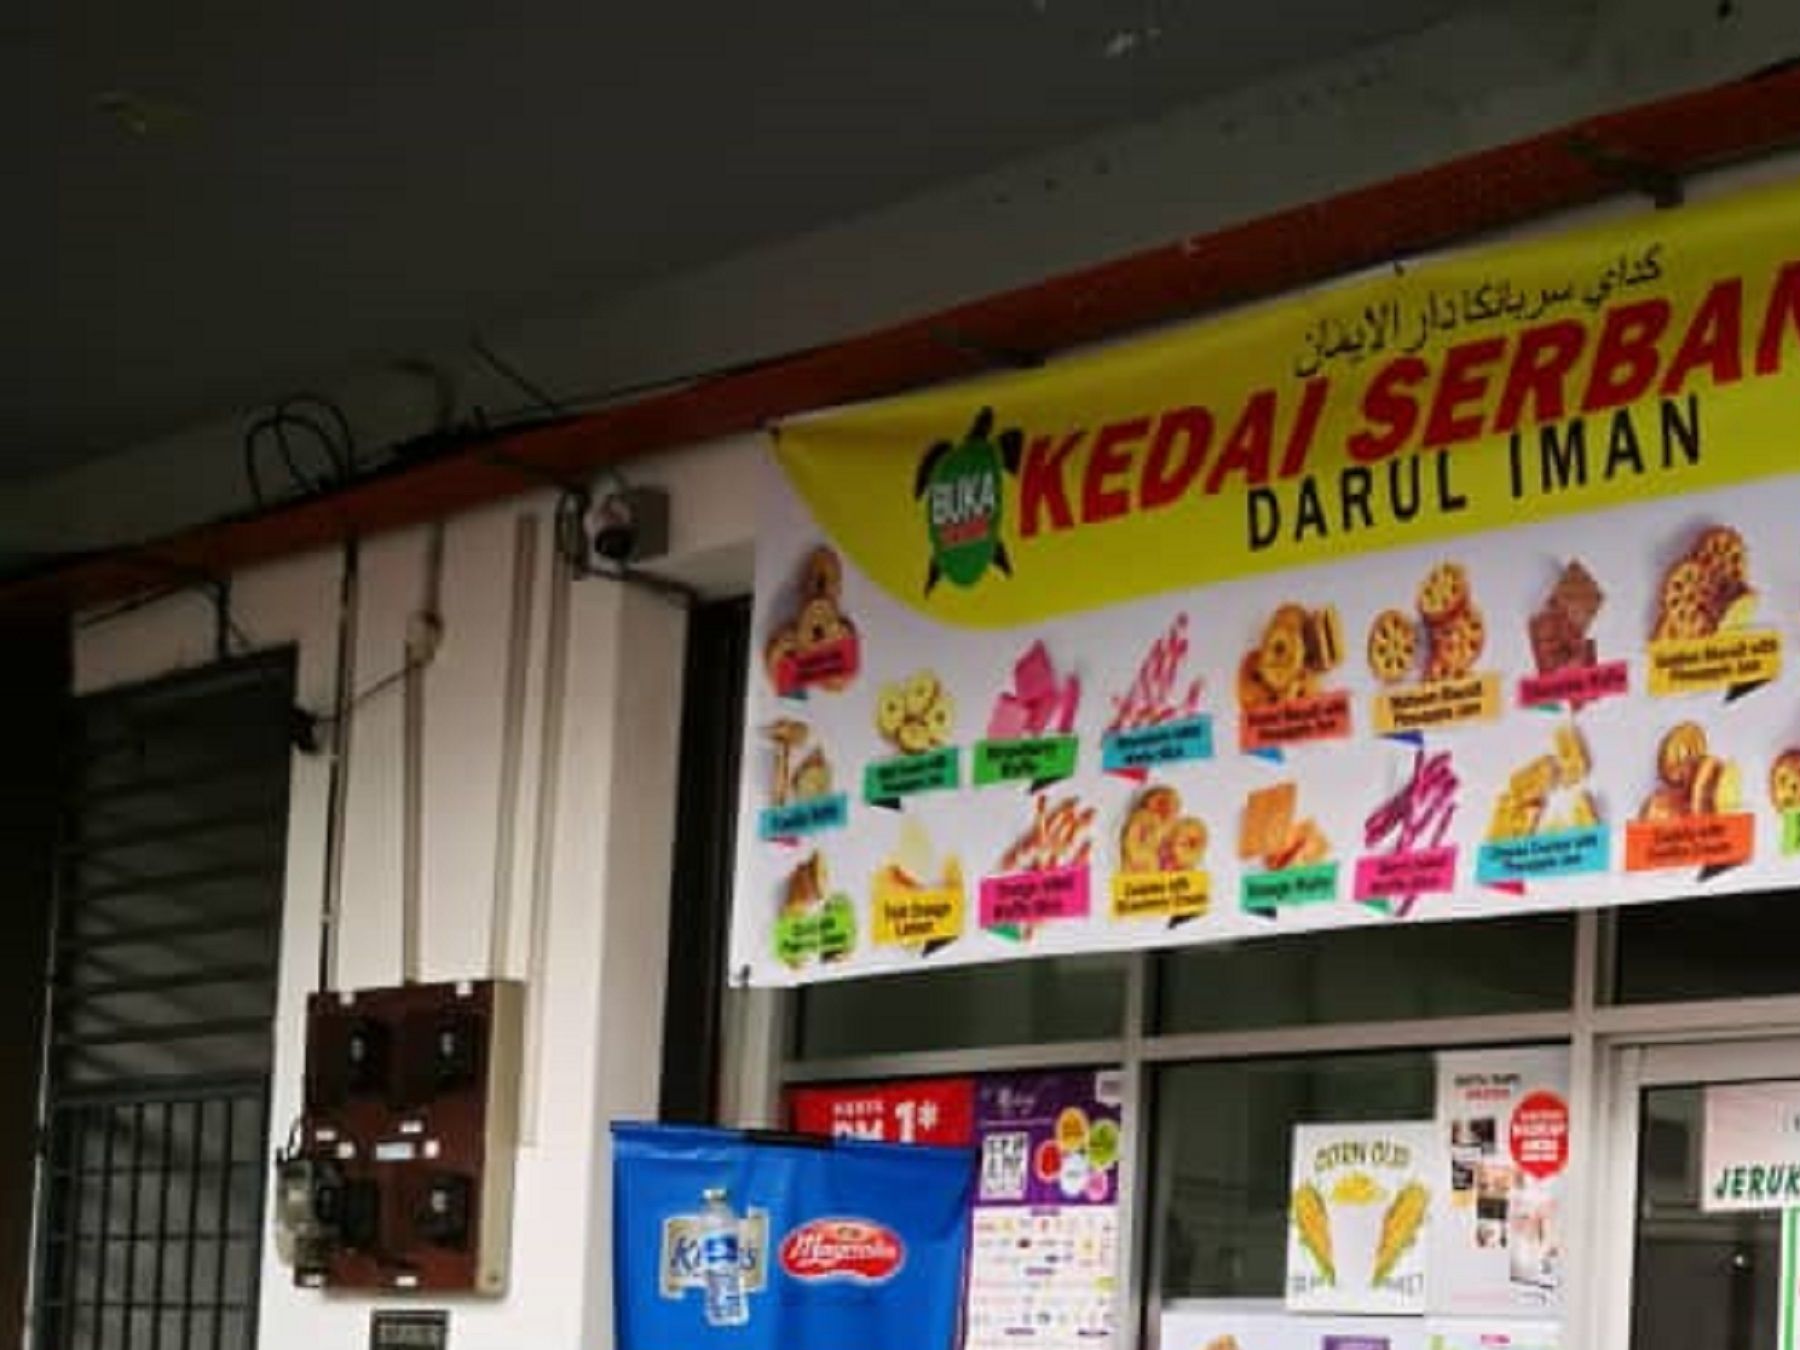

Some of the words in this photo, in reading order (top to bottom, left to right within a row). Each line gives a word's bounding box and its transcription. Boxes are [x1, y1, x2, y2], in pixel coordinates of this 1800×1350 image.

[931, 475, 995, 525] BUKA
[1016, 376, 1330, 540] KEDAI
[1247, 449, 1468, 552] DARUL
[1508, 394, 1700, 498] IMAN
